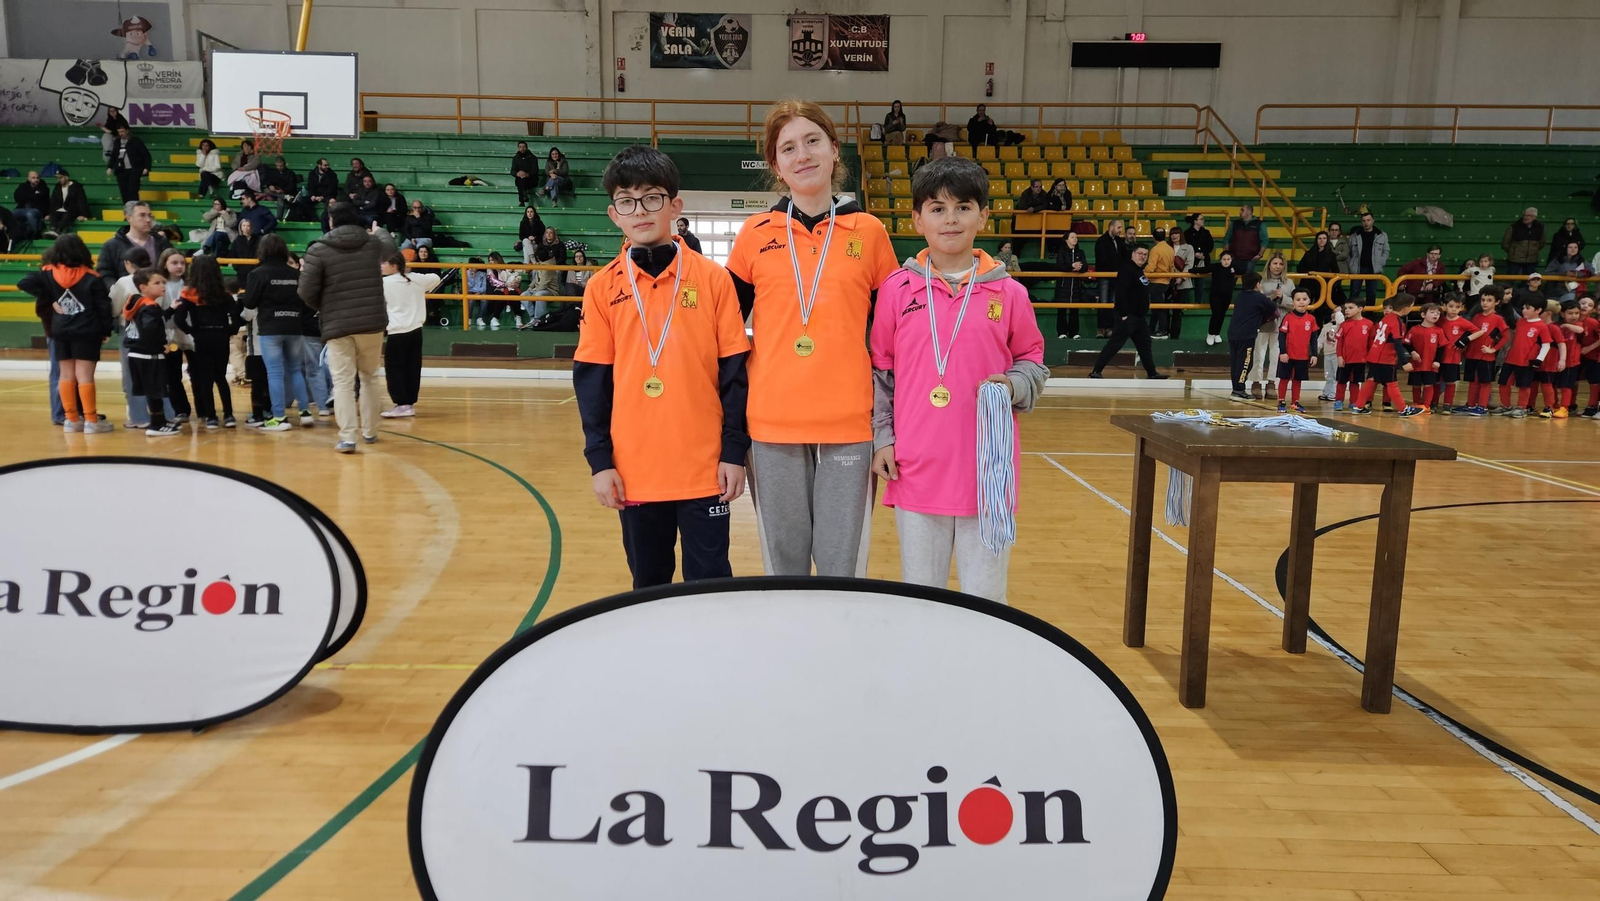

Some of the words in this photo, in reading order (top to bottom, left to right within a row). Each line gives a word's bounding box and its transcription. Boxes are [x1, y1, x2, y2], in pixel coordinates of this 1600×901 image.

[661, 26, 695, 38] VERIN
[664, 44, 693, 54] SALA
[829, 40, 888, 48] XUVENTUDE
[844, 52, 873, 62] VERÍN
[155, 69, 182, 78] VERÍN
[129, 103, 196, 126] NON
[759, 244, 786, 254] MERCURY
[902, 303, 926, 317] MERCURY
[0, 580, 23, 614] a
[37, 567, 284, 632] Región
[513, 764, 673, 847] La
[697, 765, 1090, 876] Región
